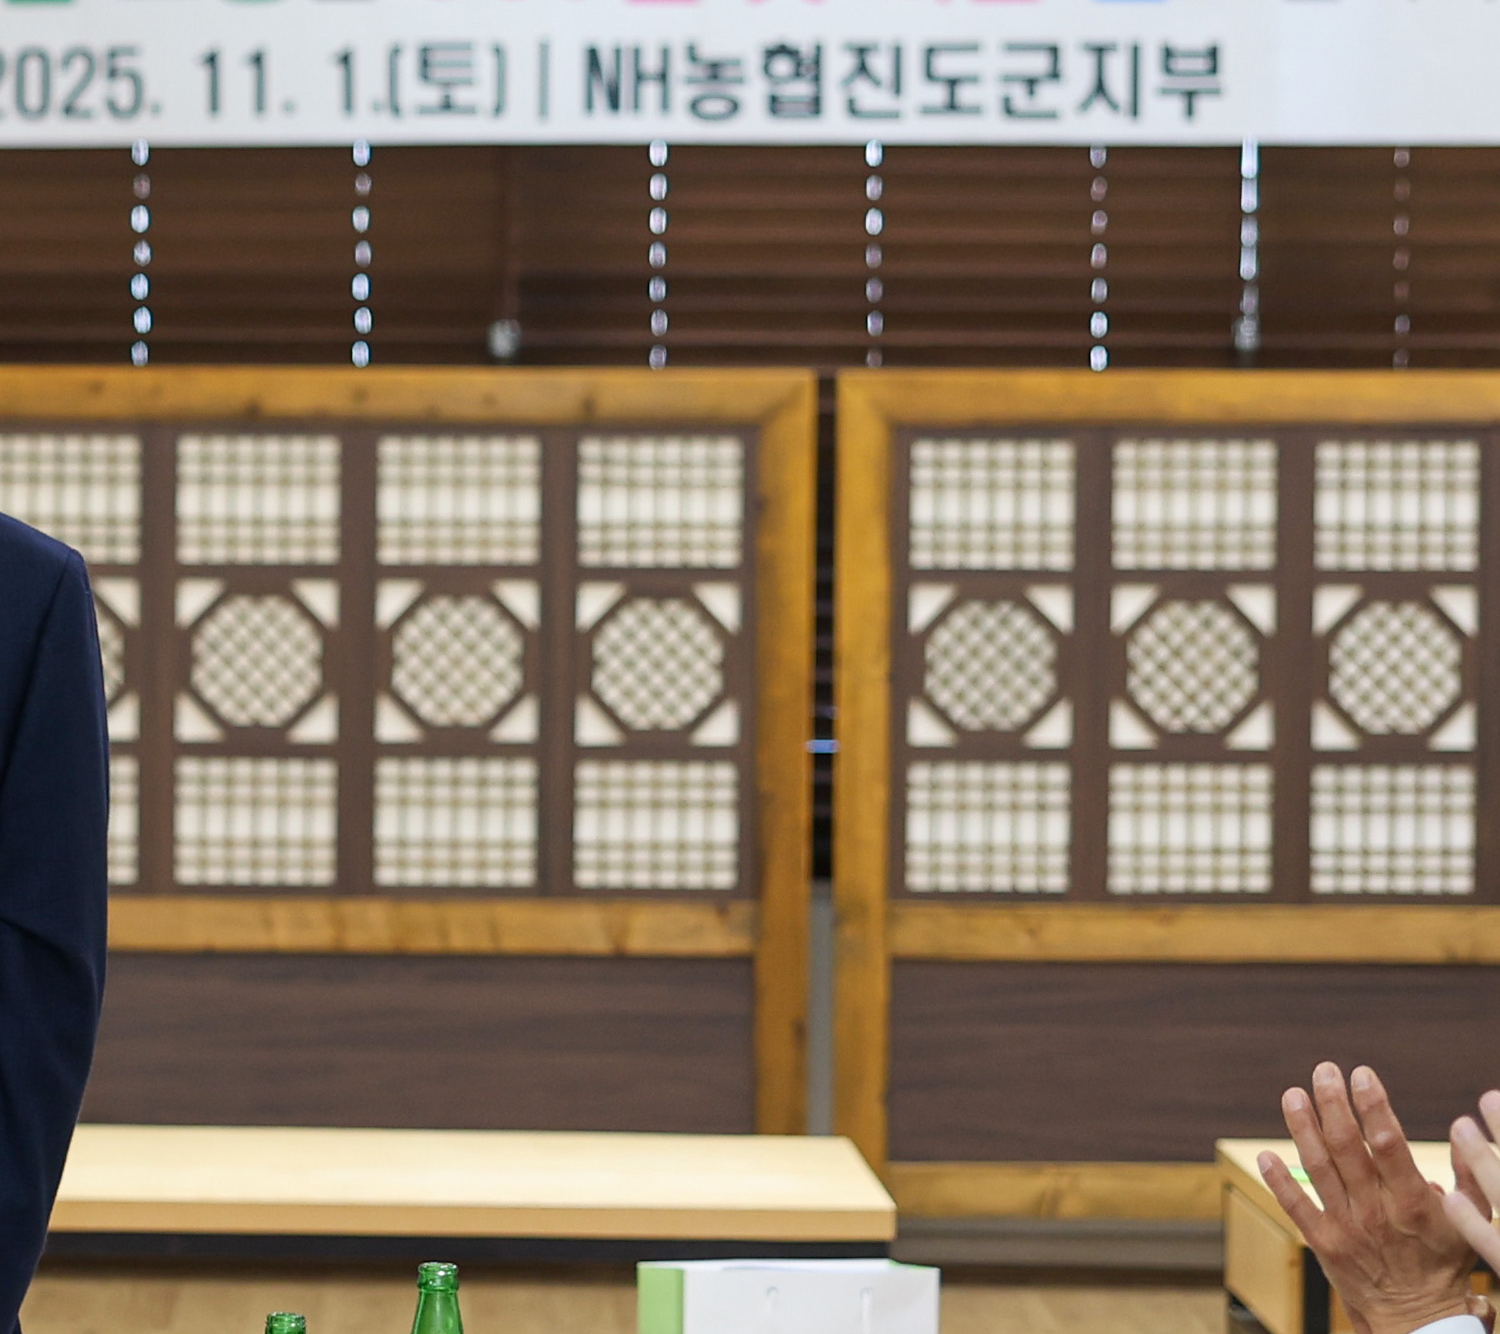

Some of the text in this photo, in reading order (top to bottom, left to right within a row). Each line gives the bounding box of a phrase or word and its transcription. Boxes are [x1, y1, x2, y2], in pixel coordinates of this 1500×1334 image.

[202, 49, 296, 116] 11.
[333, 44, 507, 118] 1.(토)
[584, 42, 1223, 122] NH농협진도군지부
